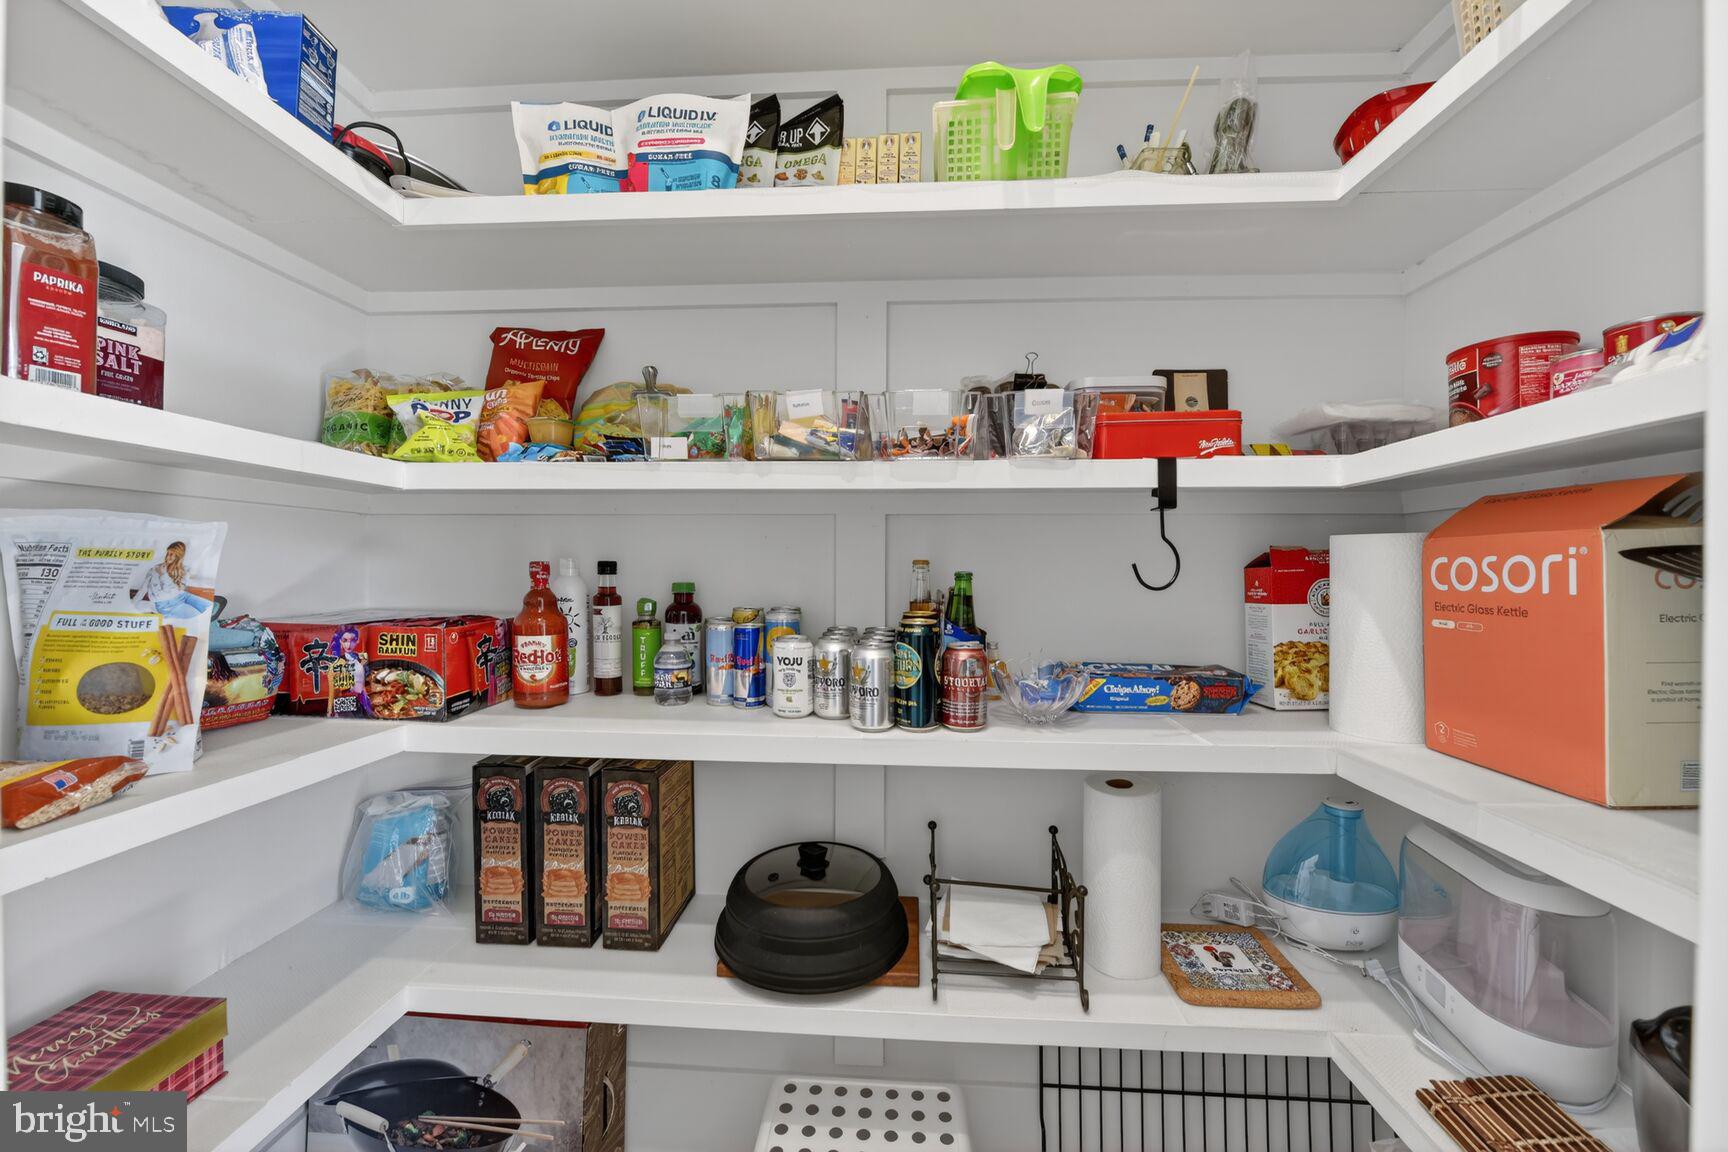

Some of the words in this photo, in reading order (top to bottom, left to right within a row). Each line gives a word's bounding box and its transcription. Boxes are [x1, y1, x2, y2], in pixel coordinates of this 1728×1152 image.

[648, 106, 698, 120] LIQUID
[700, 111, 717, 121] I.V.
[564, 119, 614, 137] LIQUID
[789, 128, 804, 144] UP
[784, 153, 827, 169] OMEGA
[33, 271, 84, 294] PAPRIKA
[97, 337, 141, 360] PINK
[96, 351, 143, 375] SALT
[48, 544, 69, 554] Facts
[125, 550, 152, 559] STORY
[40, 568, 59, 578] 130
[1434, 601, 1465, 613] Electric
[1467, 603, 1495, 615] Glass
[1497, 605, 1529, 618] Kettle
[56, 618, 78, 627] FULL
[89, 618, 114, 628] GOOD
[117, 620, 153, 629] STUFF
[1659, 613, 1697, 623] Electric
[379, 633, 417, 647] SHIN
[640, 636, 648, 677] TRUFF
[776, 656, 803, 667] YOJU
[1103, 684, 1133, 696] Chips
[1133, 685, 1160, 696] Ahoy!
[486, 811, 516, 821] KODIAK
[550, 813, 579, 823] KODIAK
[613, 816, 643, 827] KODIAK
[483, 827, 519, 836] POWER
[545, 829, 584, 838] POWER
[609, 831, 647, 841] POWER
[484, 836, 518, 844] CAKES
[547, 838, 583, 847] CAKES
[611, 841, 648, 851] CAKES
[35, 1005, 163, 1084] Christmas
